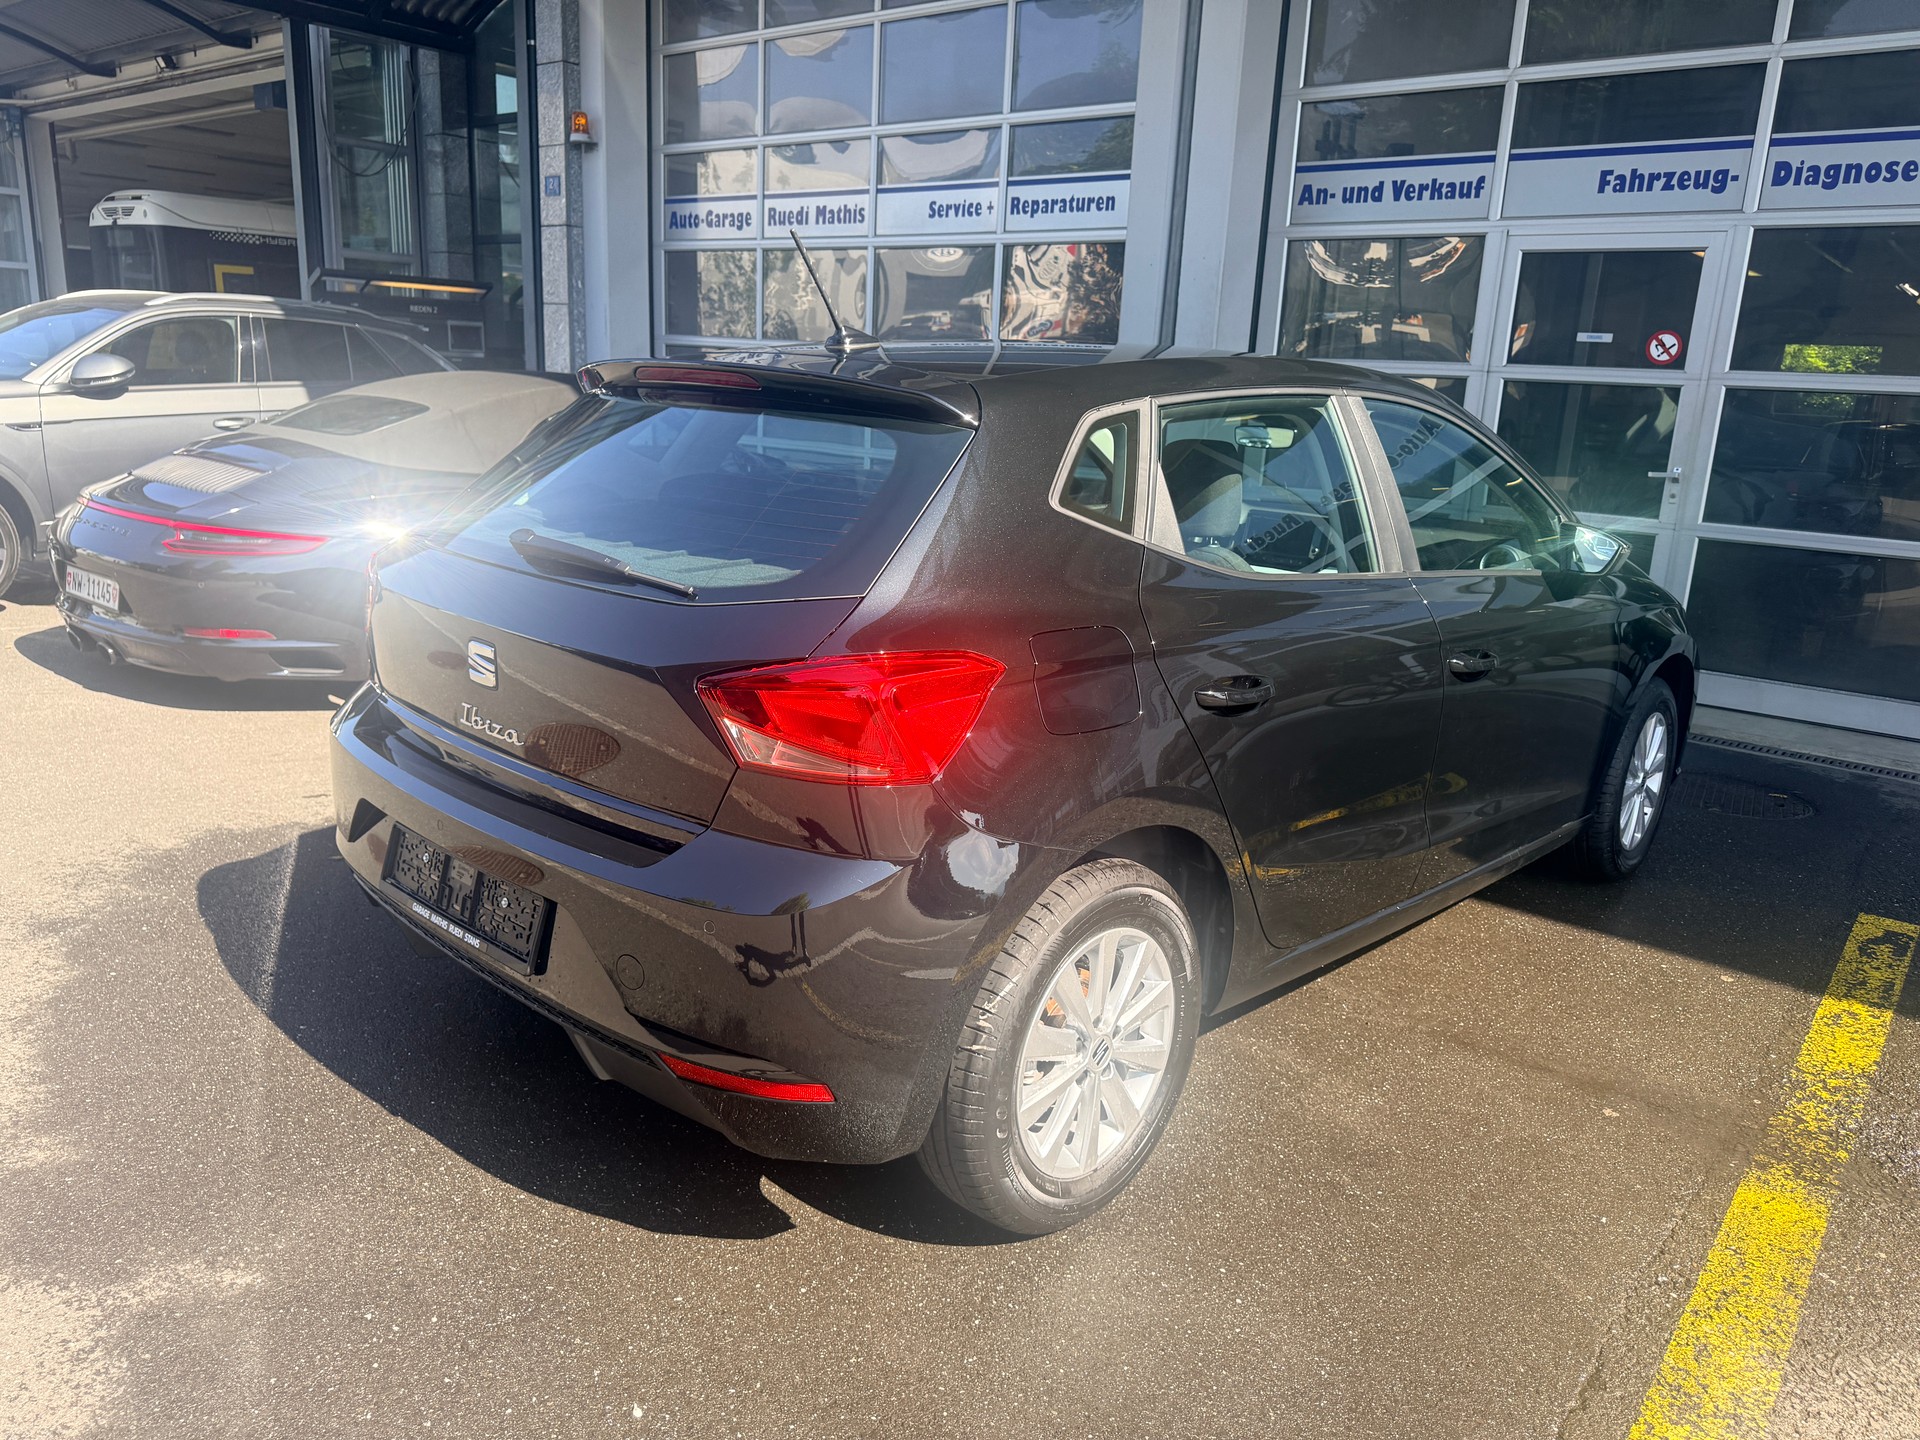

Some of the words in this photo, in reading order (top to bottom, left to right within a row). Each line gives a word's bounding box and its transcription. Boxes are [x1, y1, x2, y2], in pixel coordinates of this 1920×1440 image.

[1297, 184, 1336, 206] An-
[1341, 181, 1385, 204] und
[1391, 175, 1487, 202] Verkauf
[1597, 167, 1740, 194] Fahrzeug-
[1770, 159, 1919, 191] Diagnose
[669, 208, 752, 231] Auto-Garage
[767, 205, 809, 227] Ruedi
[815, 203, 866, 226] Mathis
[928, 200, 982, 219] Service
[1010, 193, 1116, 218] Reparaturen
[460, 702, 525, 746] Ibiza
[412, 902, 431, 919] GARAGE
[430, 913, 449, 930] MATHIS
[448, 923, 464, 939] RUEDI
[463, 933, 481, 949] STANS
